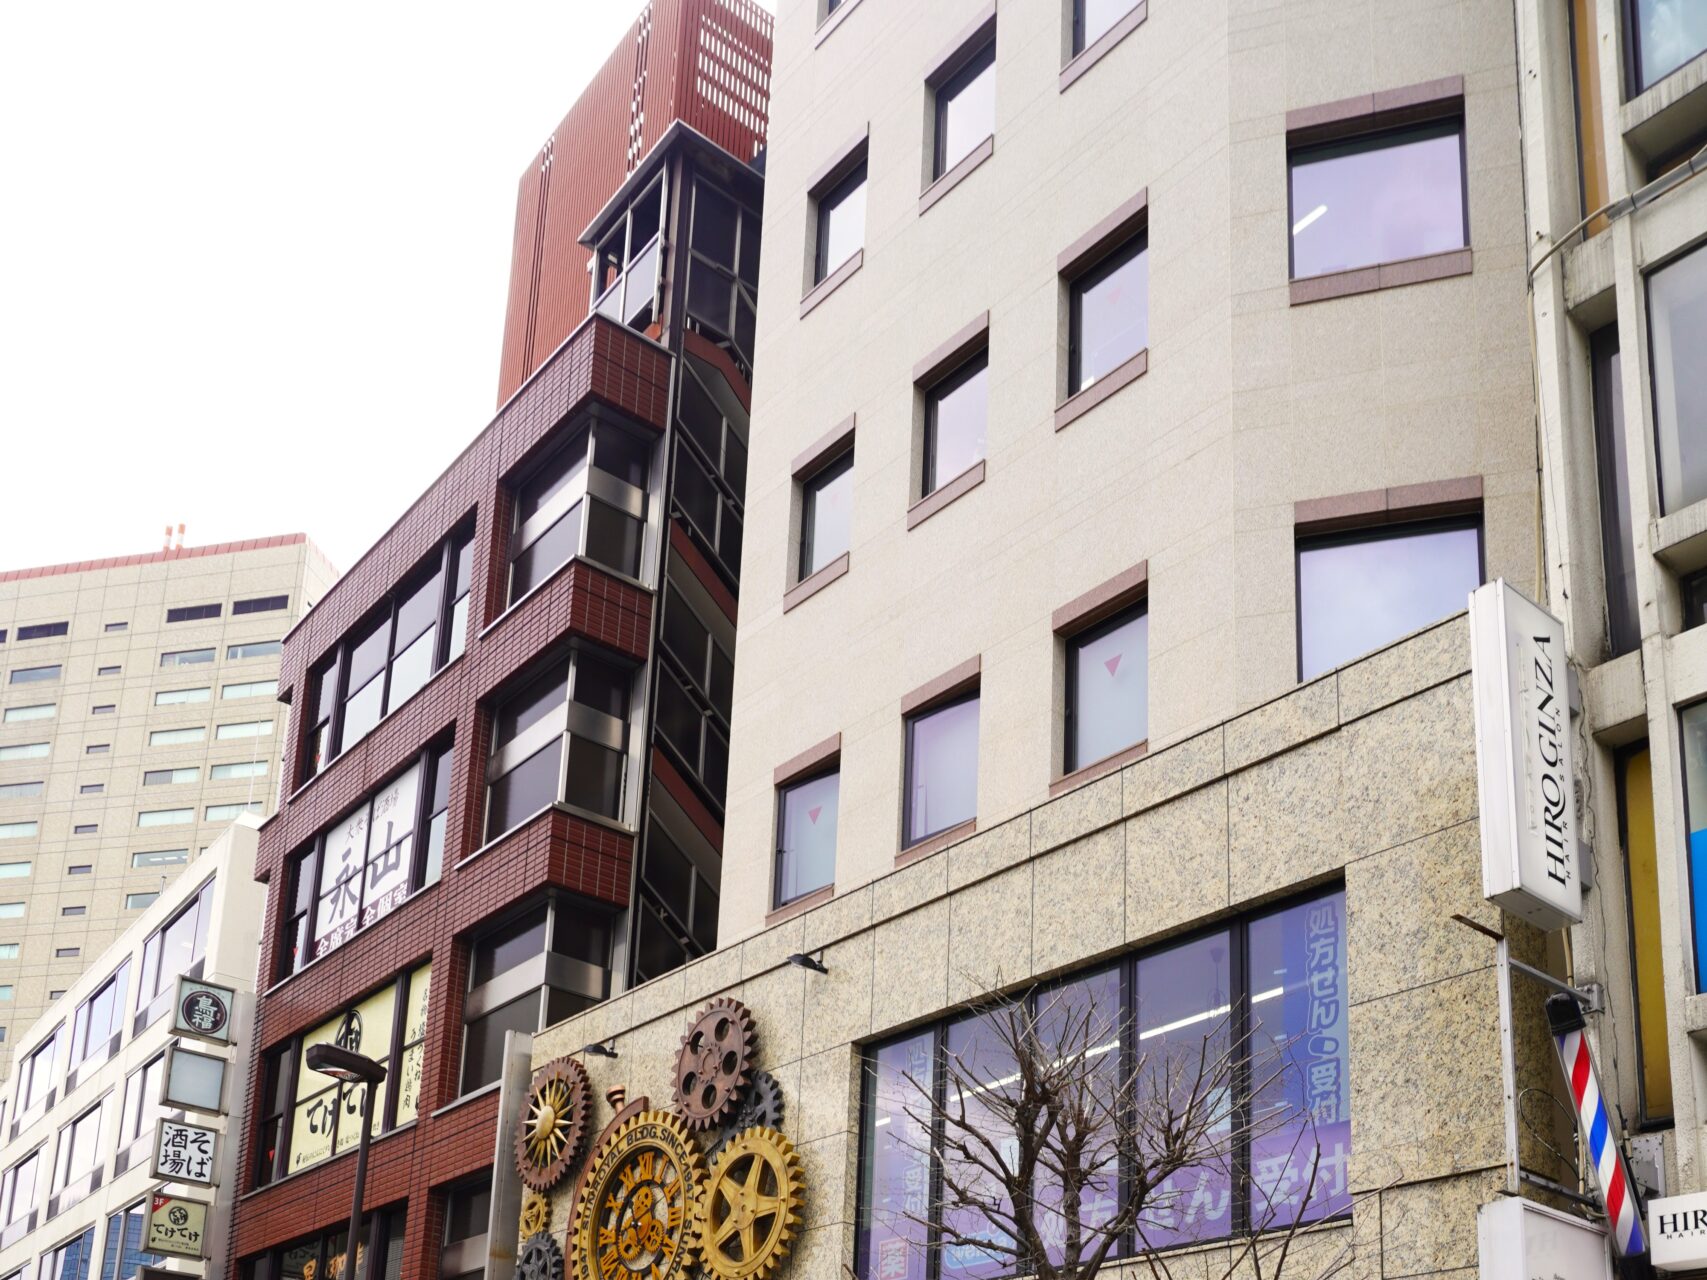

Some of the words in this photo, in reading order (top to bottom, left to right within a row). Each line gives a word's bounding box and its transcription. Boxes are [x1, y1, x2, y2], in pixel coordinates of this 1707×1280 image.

[1533, 634, 1559, 768] GINZA
[1555, 708, 1566, 782] SALON
[1541, 773, 1566, 888] HIRO
[1561, 820, 1572, 879] HAIR
[1308, 908, 1338, 1031] 処方せん
[307, 1080, 366, 1138] てけて
[160, 1125, 189, 1175] 酒場
[187, 1131, 213, 1179] そば
[581, 1144, 624, 1231] SUNROYAL
[660, 1127, 688, 1164] SINCE
[153, 1197, 165, 1206] 3F
[153, 1223, 200, 1243] てけてけ
